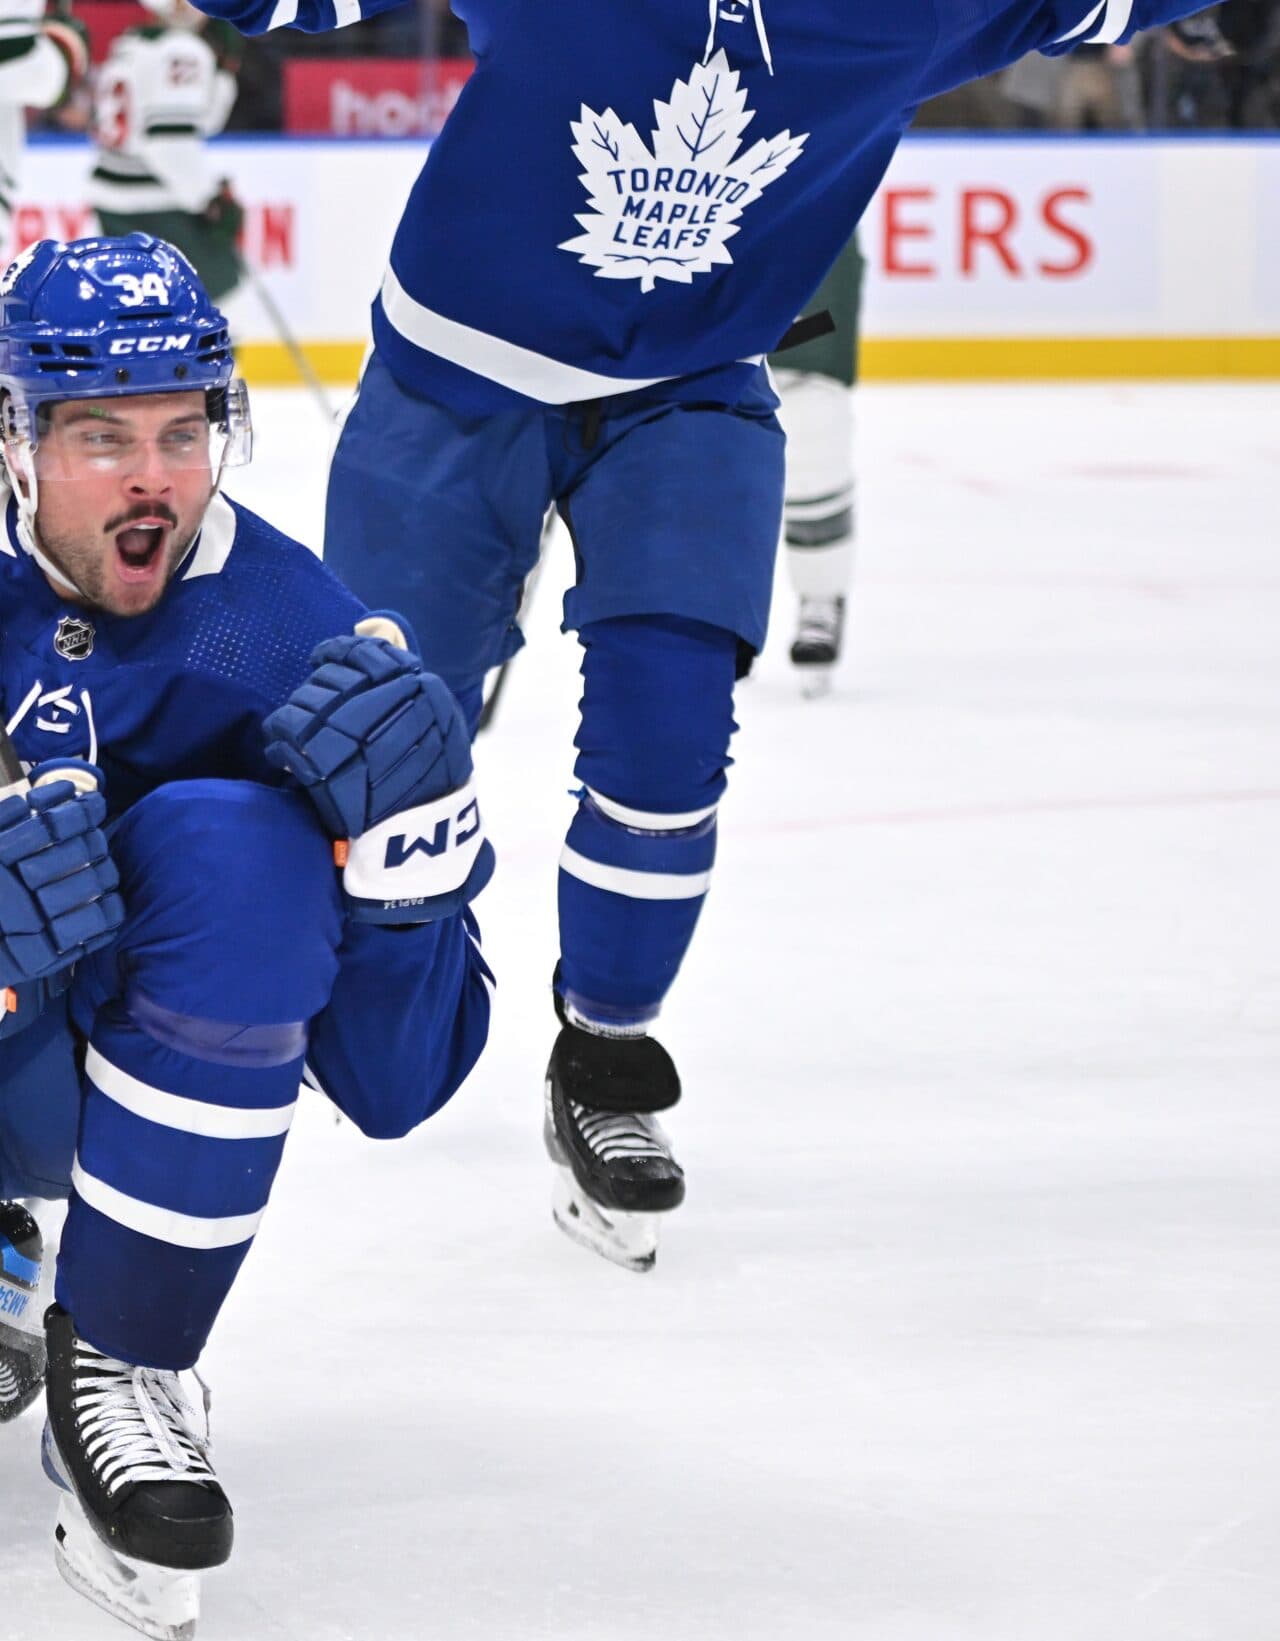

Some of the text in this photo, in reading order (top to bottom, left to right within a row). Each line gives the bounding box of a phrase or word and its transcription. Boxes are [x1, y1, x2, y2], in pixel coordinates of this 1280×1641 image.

[606, 167, 750, 204] TORONTO
[622, 195, 723, 225] MAPLE
[612, 221, 711, 250] LEAFS
[113, 272, 170, 307] 34
[109, 333, 193, 355] CCM
